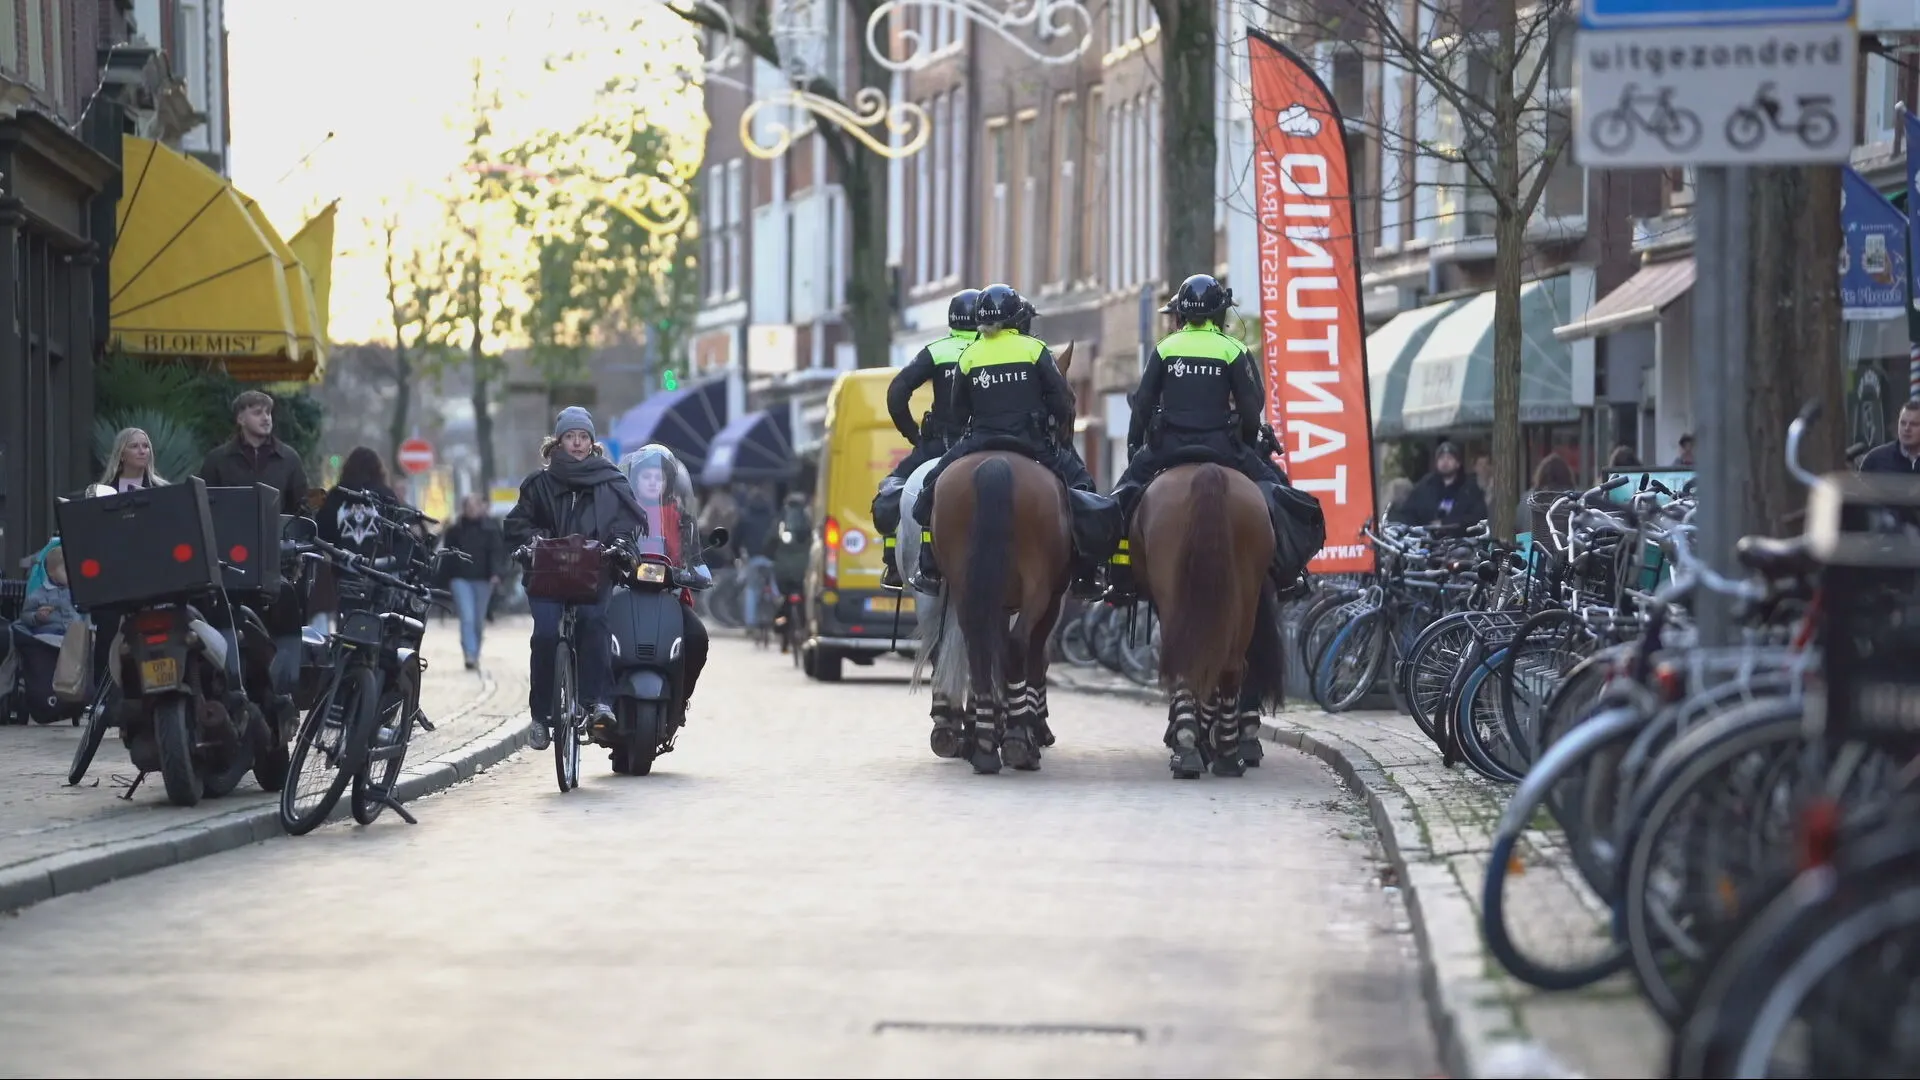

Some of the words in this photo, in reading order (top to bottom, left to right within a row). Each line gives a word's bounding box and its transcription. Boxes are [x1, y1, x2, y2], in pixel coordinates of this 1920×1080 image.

[1589, 34, 1842, 78] uitgezonderd
[144, 334, 261, 353] BLOEMIST
[1168, 358, 1222, 377] POLITIE
[972, 368, 1028, 388] POLITIE
